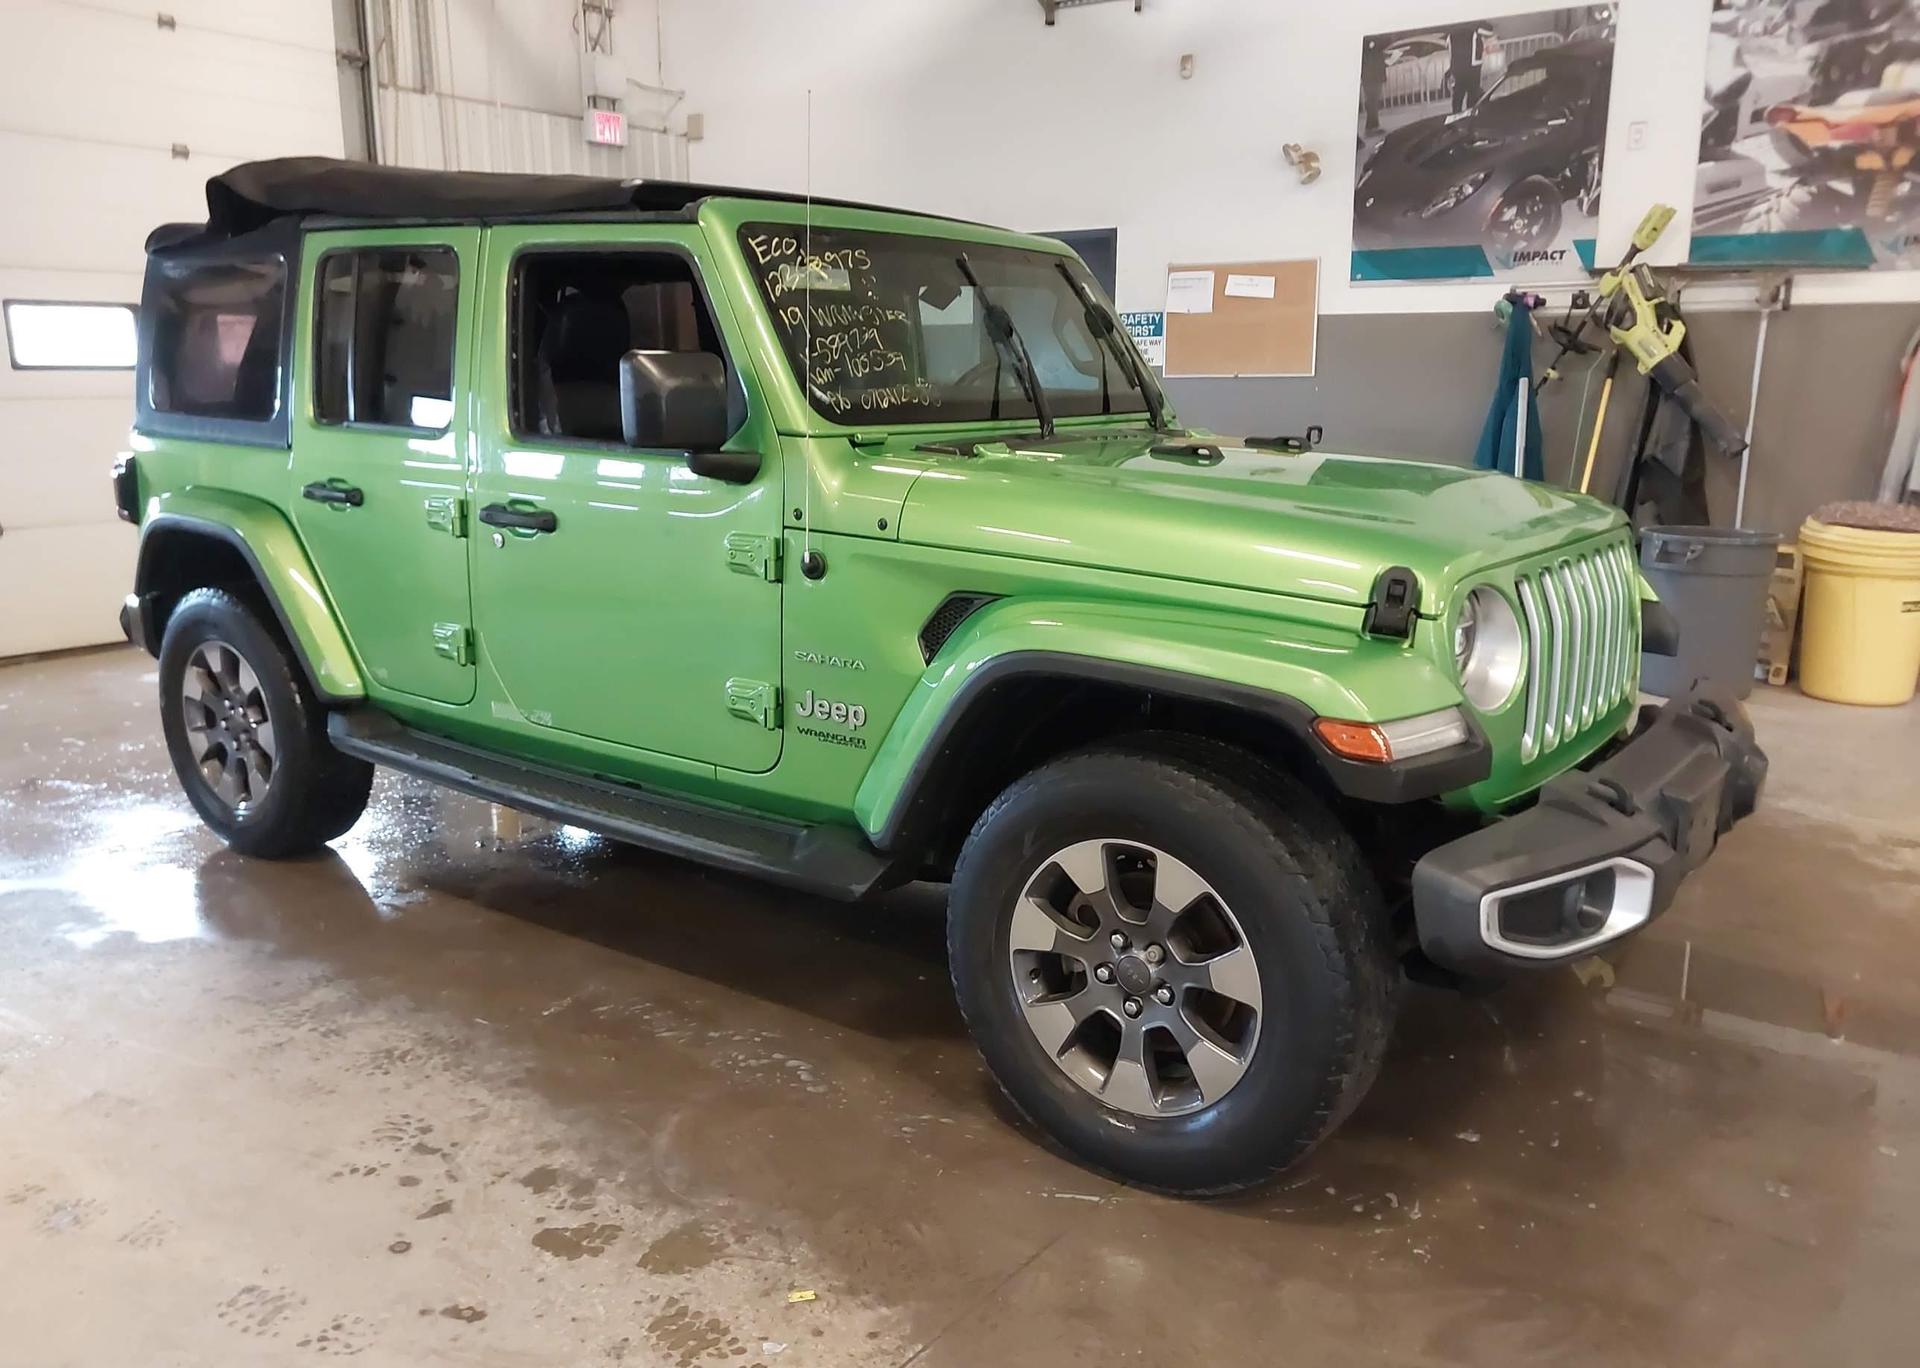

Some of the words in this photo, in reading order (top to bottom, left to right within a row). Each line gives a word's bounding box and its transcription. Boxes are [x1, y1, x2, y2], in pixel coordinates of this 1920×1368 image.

[596, 113, 621, 144] EXIT
[1513, 249, 1567, 263] IMPACT
[1121, 313, 1161, 325] SAFETY
[794, 650, 867, 671] SAHARA
[795, 688, 867, 731] Jeep
[796, 725, 866, 747] WRANGLER
